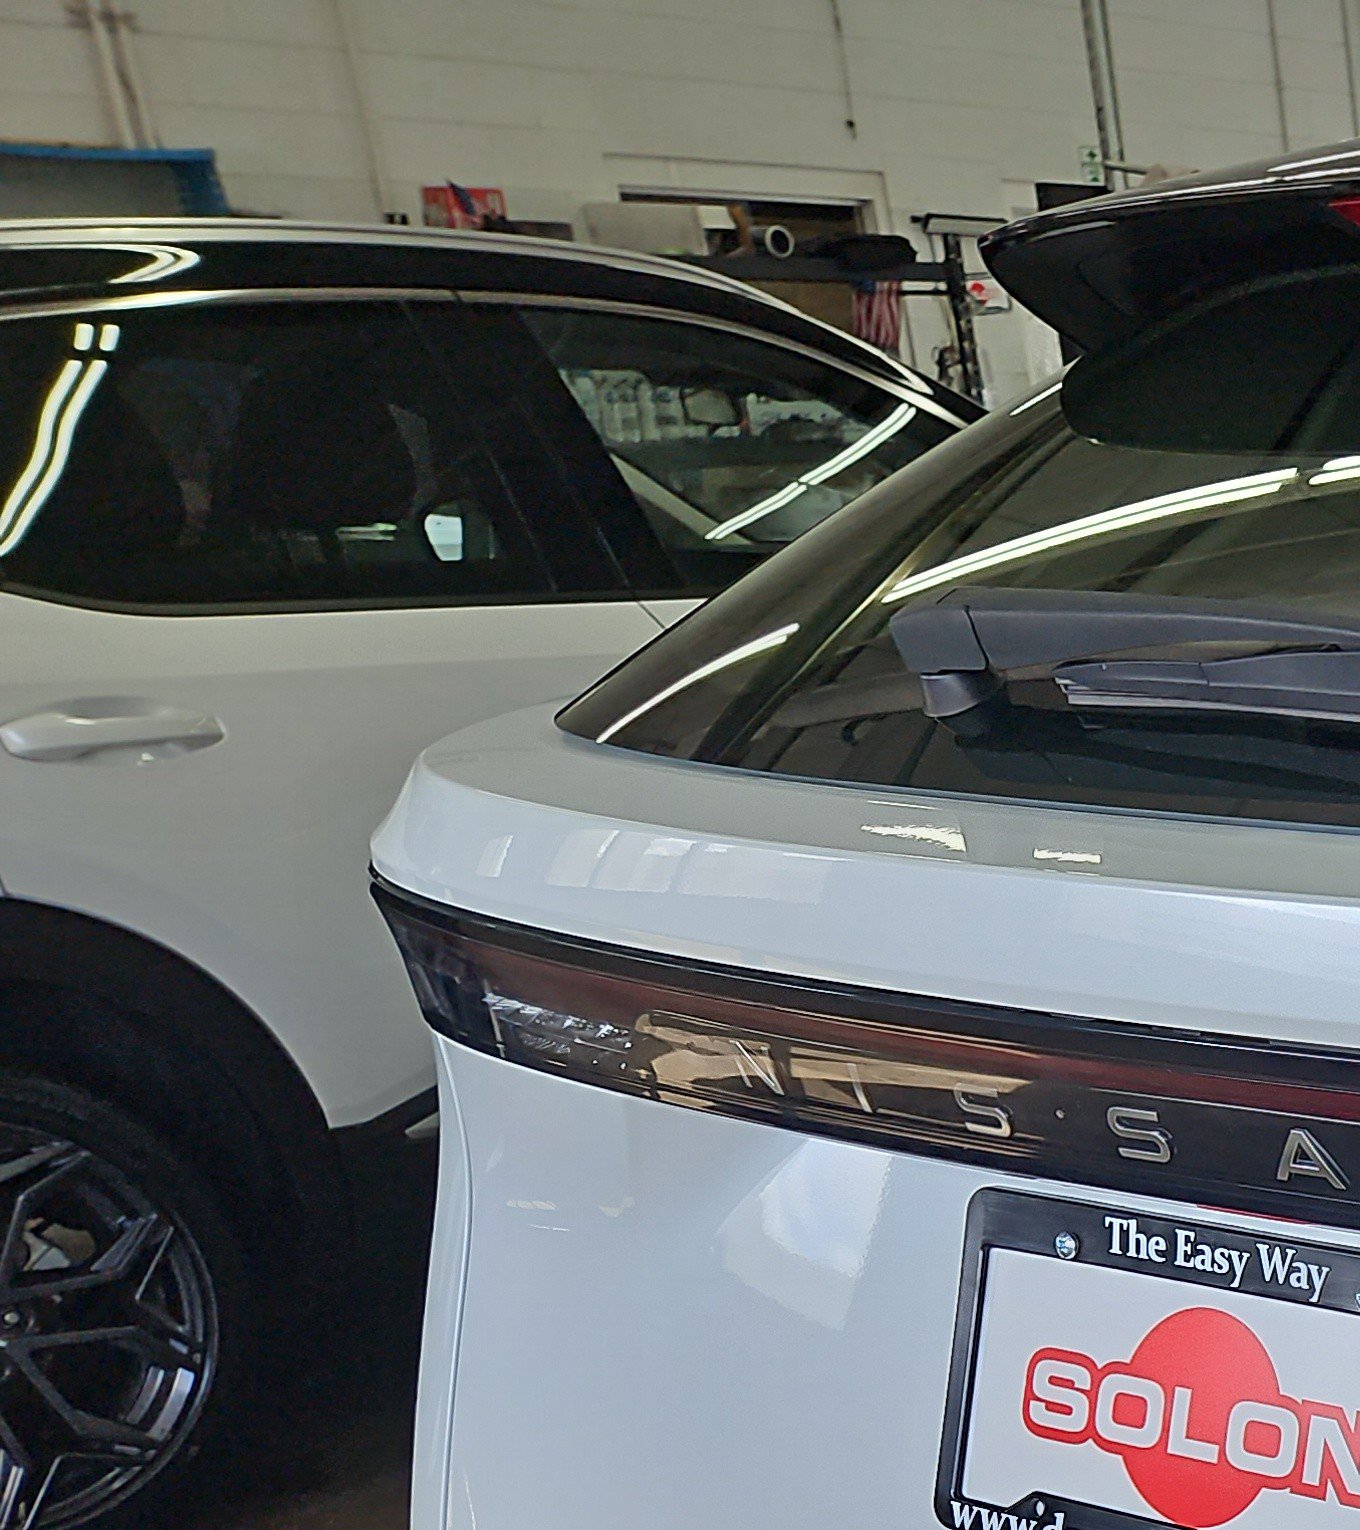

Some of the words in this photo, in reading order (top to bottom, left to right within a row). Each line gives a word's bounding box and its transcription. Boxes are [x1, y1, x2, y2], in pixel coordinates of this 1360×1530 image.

[1104, 1215, 1167, 1264] The
[1173, 1229, 1251, 1288] Easy
[1257, 1244, 1331, 1302] Way
